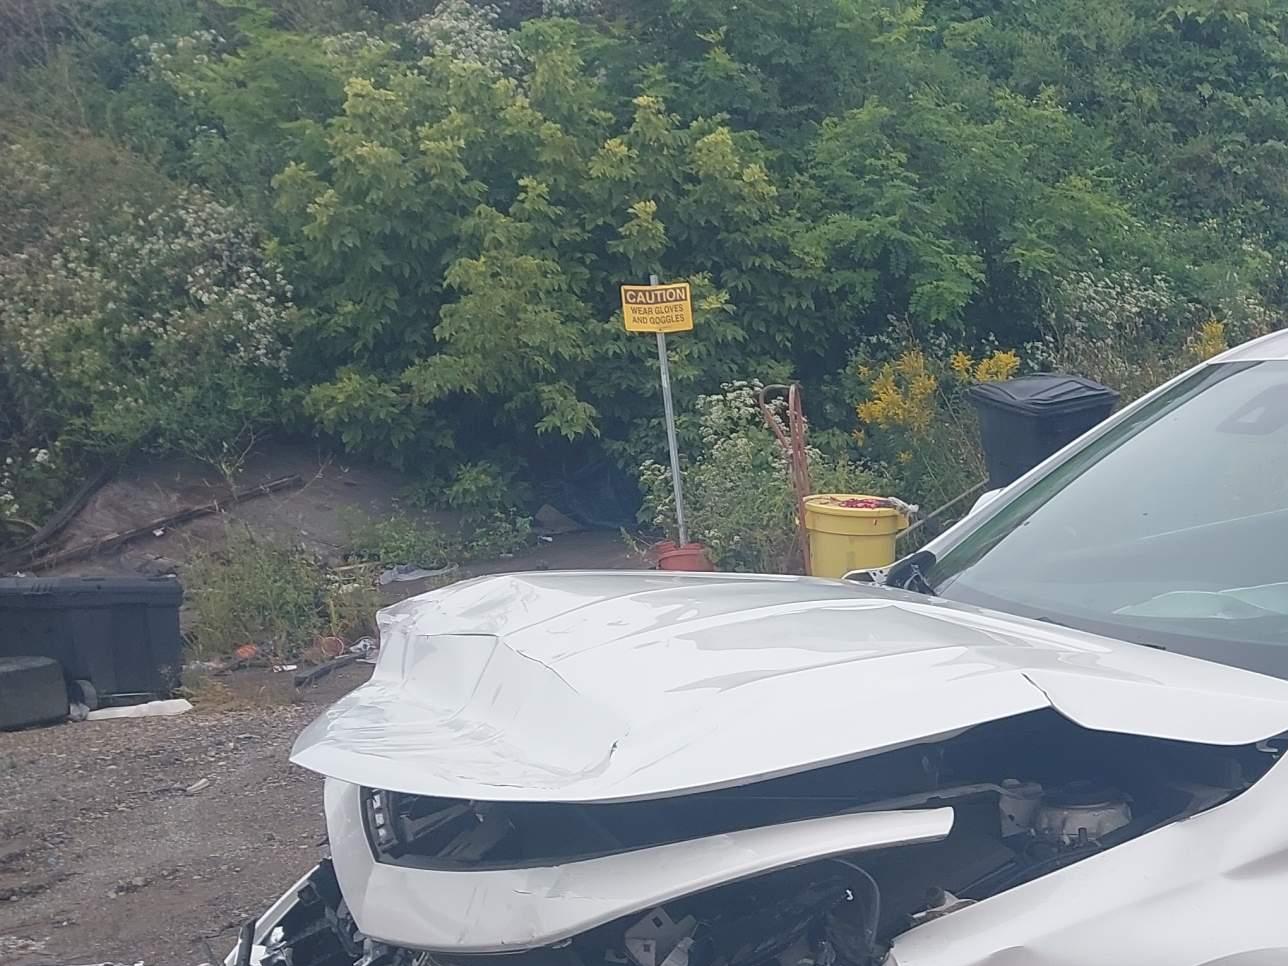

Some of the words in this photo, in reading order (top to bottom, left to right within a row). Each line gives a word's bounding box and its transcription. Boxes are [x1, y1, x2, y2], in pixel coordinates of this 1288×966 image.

[626, 287, 686, 304] CAUTION
[631, 306, 653, 315] WEAR
[655, 304, 684, 315] GLOVES
[633, 316, 648, 325] AND
[649, 313, 685, 325] GOGGLES
